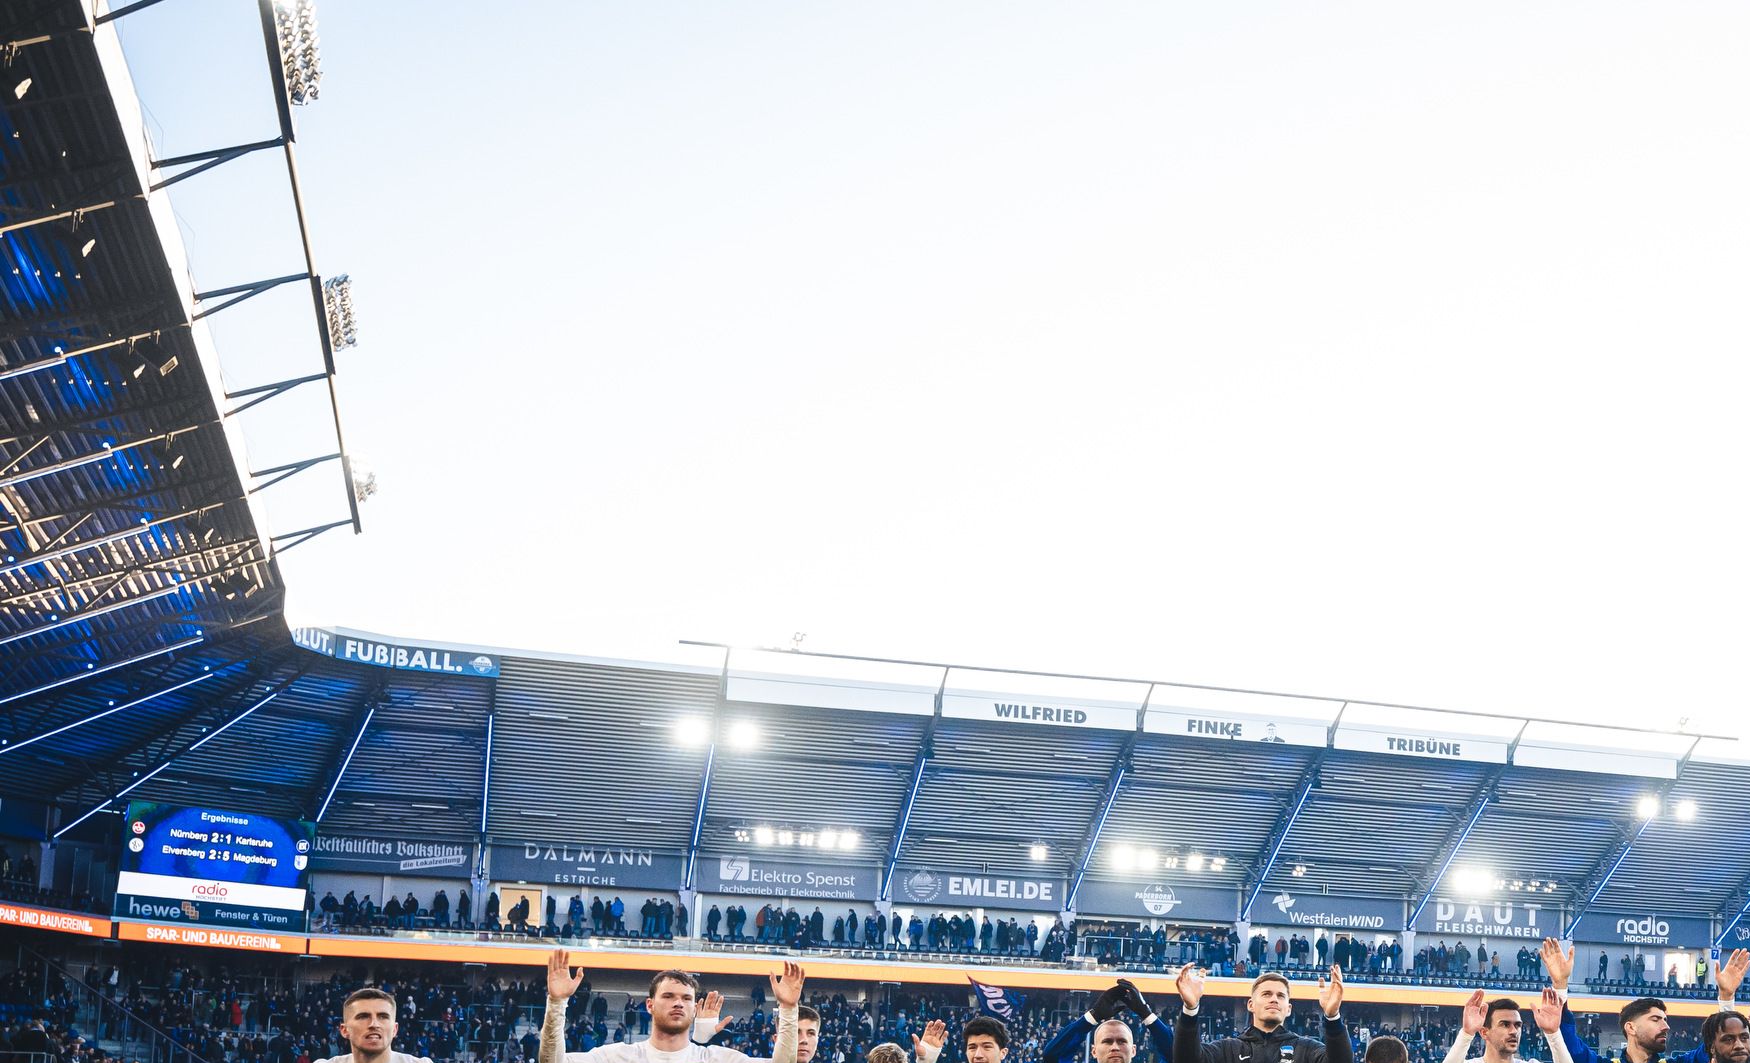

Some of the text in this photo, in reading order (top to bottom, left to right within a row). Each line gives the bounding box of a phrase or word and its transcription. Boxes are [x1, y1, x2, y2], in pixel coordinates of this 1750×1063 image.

[995, 703, 1087, 724] WILFRIED
[1187, 719, 1242, 737] FINKE
[1387, 737, 1461, 756] TRIBÜNE
[201, 812, 249, 826] Ergebnisse
[170, 828, 274, 848] Nürnberg 2:1 Karlsruhe
[209, 850, 230, 861] 2:5
[233, 852, 278, 867] Magdeburg
[525, 842, 654, 866] DALMANN
[555, 874, 616, 886] ESTRICHE
[751, 869, 856, 887] Elektro Spenst
[192, 883, 228, 896] radio
[719, 884, 856, 899] Fachbetrieb für Elektrotechnik
[948, 877, 1053, 900] EMLEI.DE
[129, 896, 181, 919] hewe
[215, 909, 250, 921] Fenster
[262, 913, 288, 924] Türen
[1436, 898, 1542, 926] DAUT
[20, 911, 39, 924] UND
[40, 914, 85, 931] BAUVEREIN
[1290, 911, 1384, 928] WestfalenWIND
[1616, 913, 1670, 936] radio
[146, 927, 270, 948] SPAR- UND BAUVEREIN
[1436, 922, 1540, 937] FLEISCHWAREN
[1623, 935, 1669, 944] HOCHSTIFT
